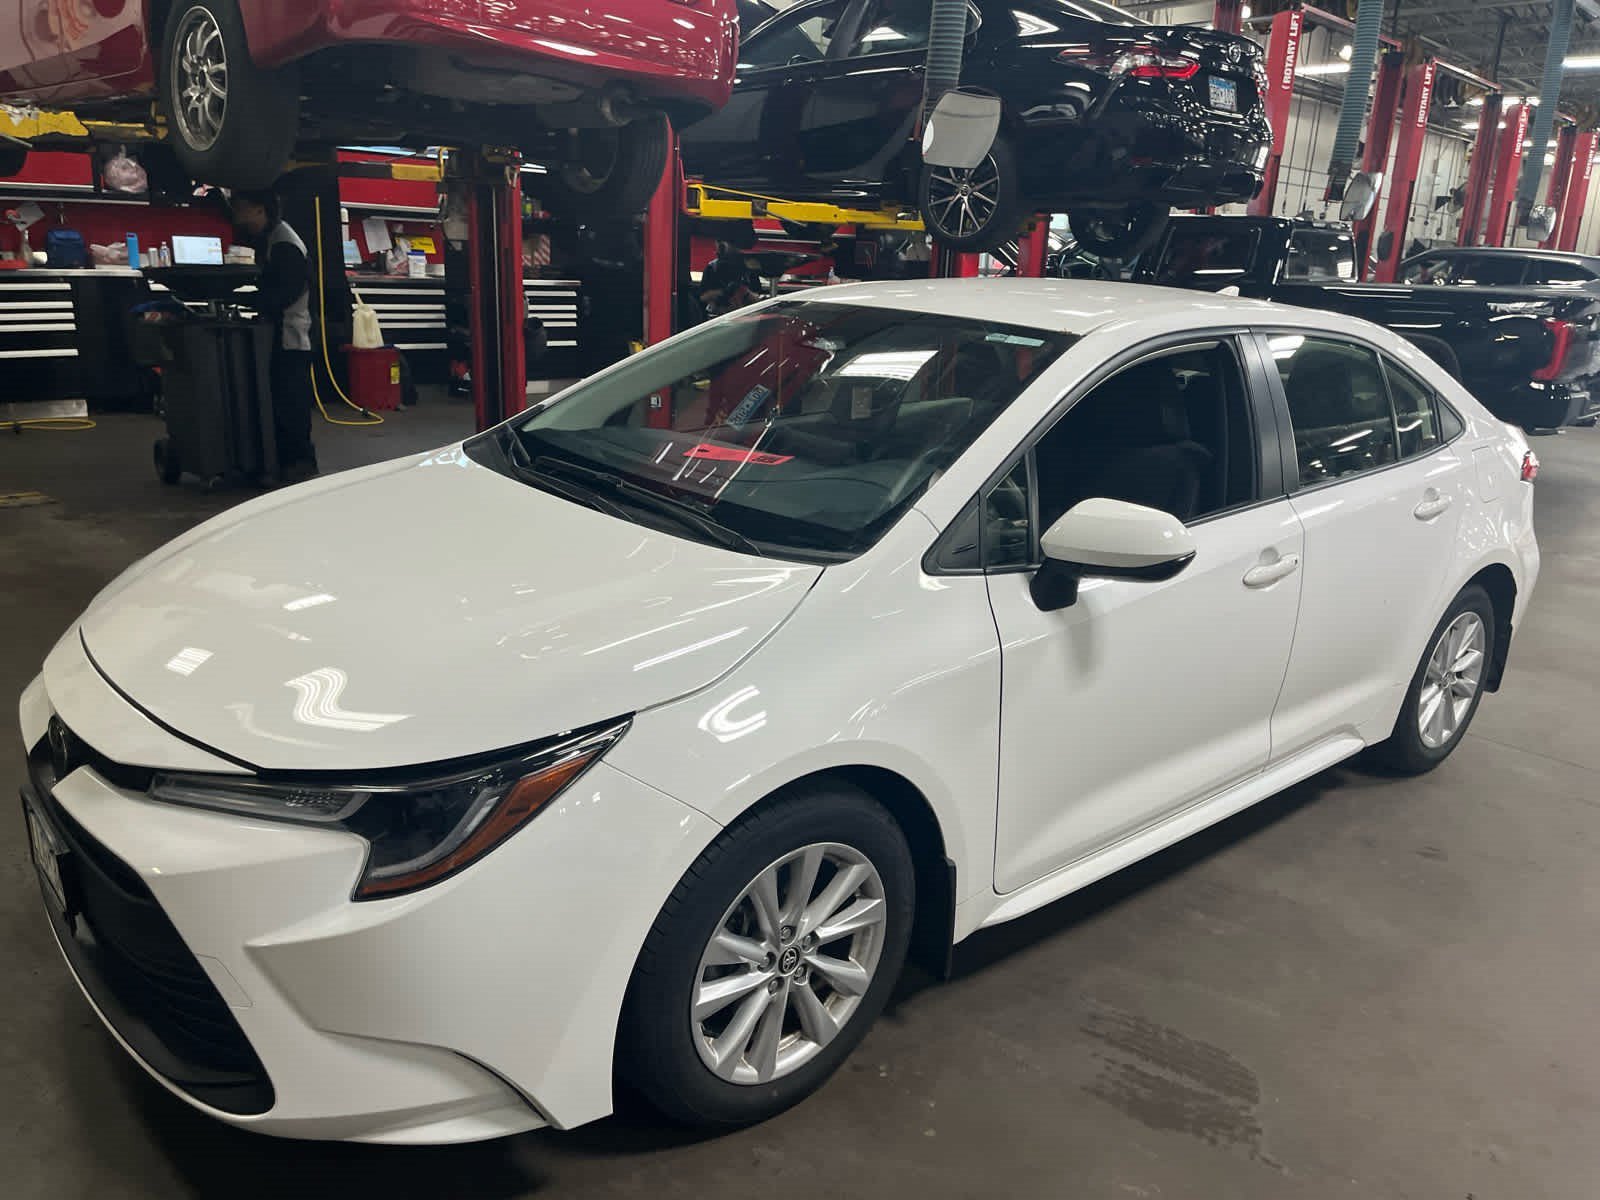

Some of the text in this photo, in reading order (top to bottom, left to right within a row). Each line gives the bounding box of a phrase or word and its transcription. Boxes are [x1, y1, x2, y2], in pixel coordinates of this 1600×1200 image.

[1282, 13, 1300, 84] ROTARY LIFT
[1418, 65, 1433, 123] ROTARY LIFT
